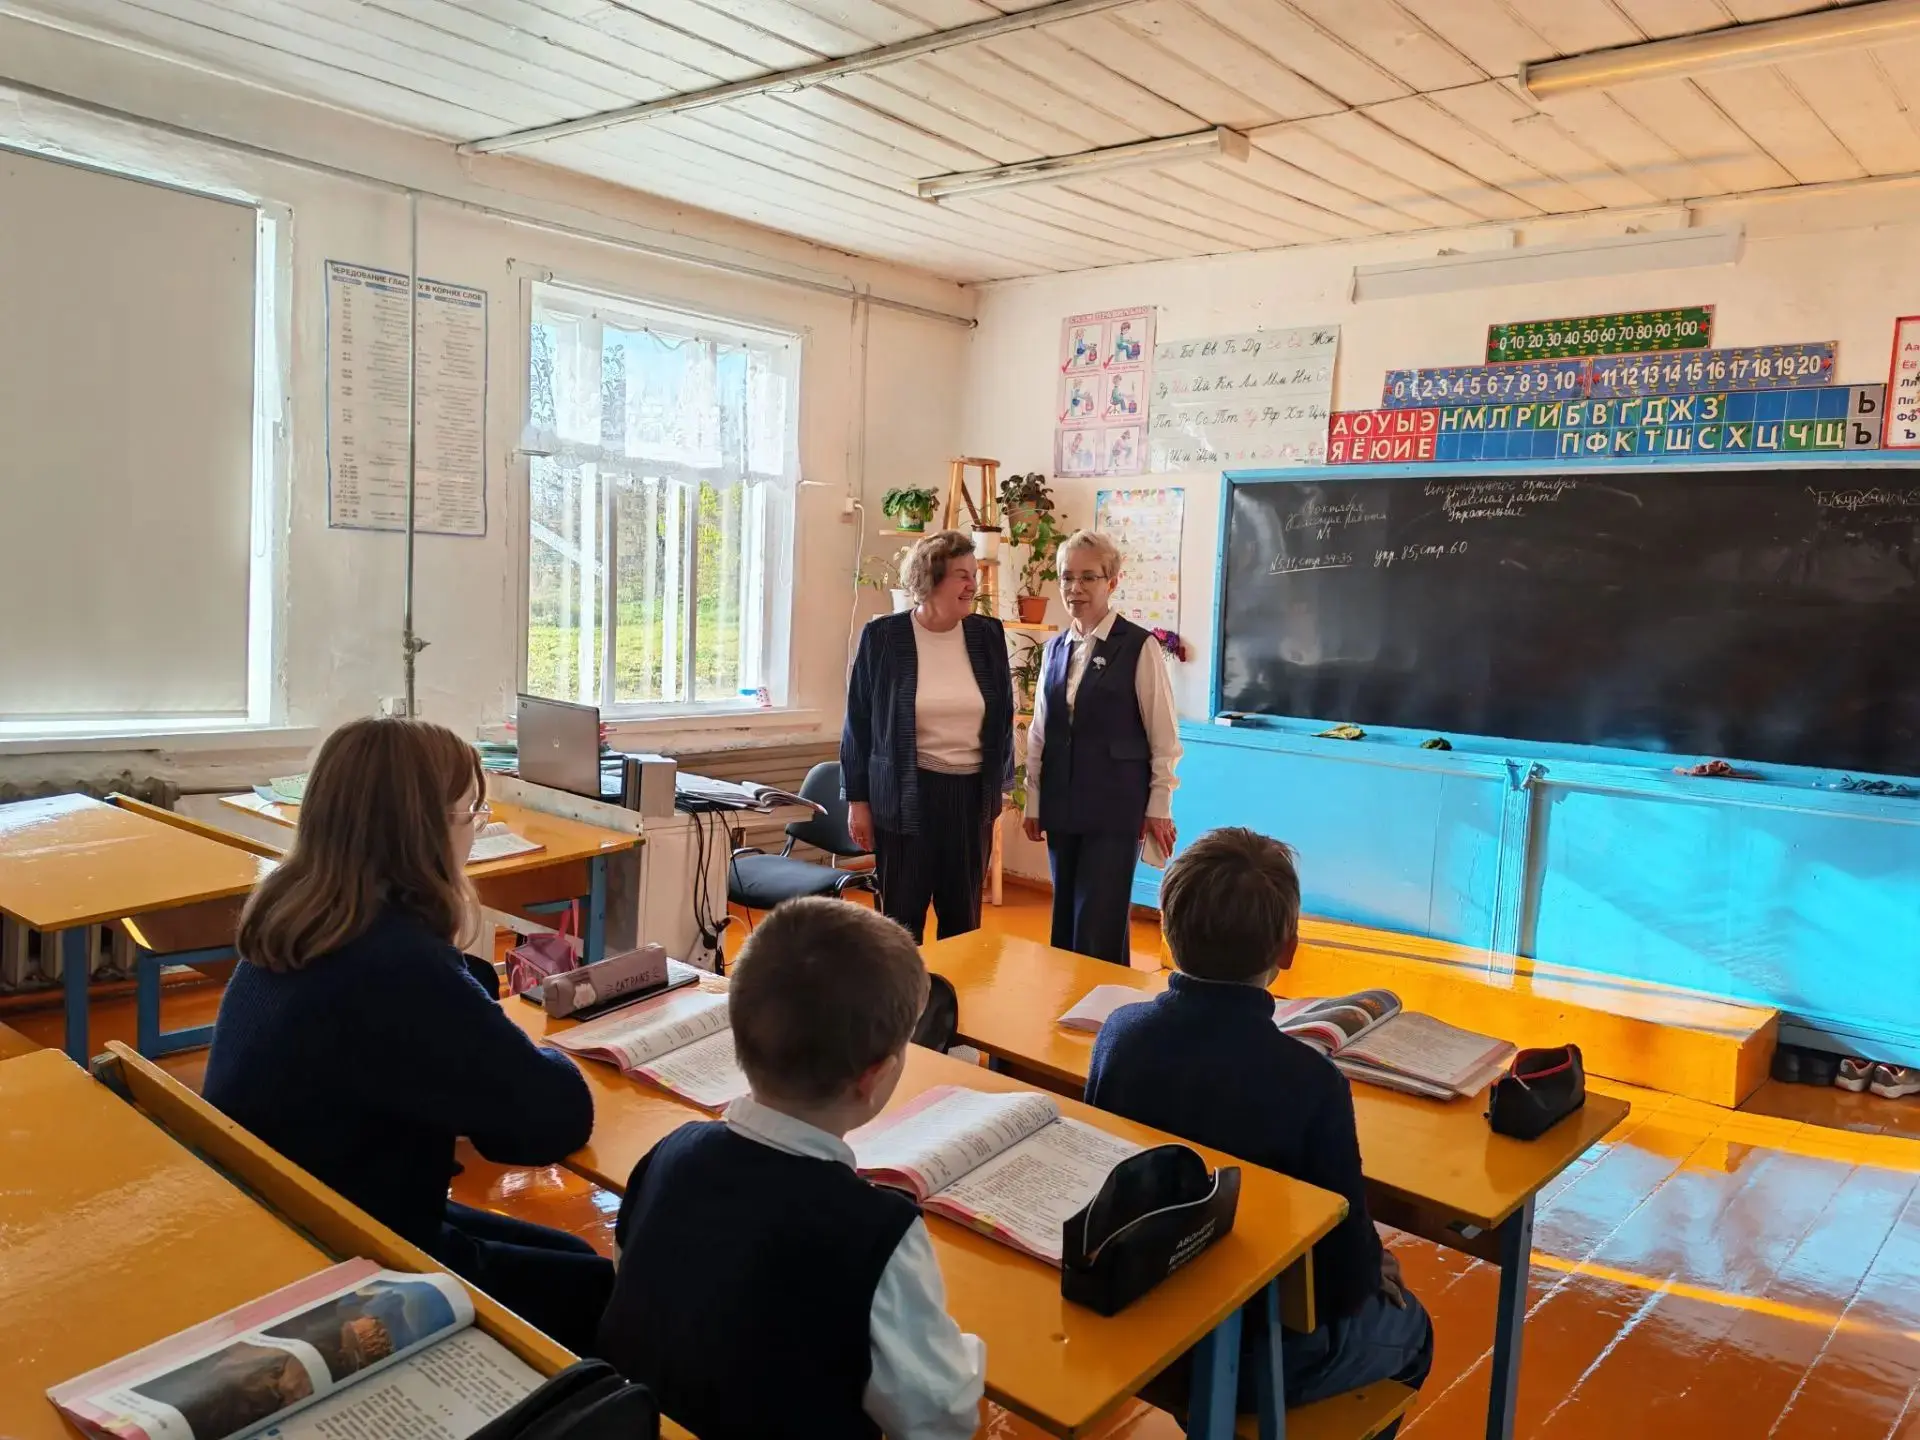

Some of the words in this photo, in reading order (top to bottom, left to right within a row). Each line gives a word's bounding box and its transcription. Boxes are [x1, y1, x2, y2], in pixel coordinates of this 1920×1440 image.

[463, 291, 482, 301] СЛОВ
[1500, 337, 1507, 350] 0
[1510, 336, 1524, 349] 10
[1528, 334, 1542, 348] 20
[1546, 332, 1562, 347] 30
[1564, 331, 1580, 345] 40
[1583, 329, 1598, 344] 50
[1600, 328, 1616, 342] 60
[1619, 326, 1634, 340] 70
[1636, 324, 1652, 339] 80
[1655, 323, 1671, 338] 90
[1674, 321, 1697, 336] 100
[1395, 381, 1404, 398] 0
[1410, 381, 1418, 398] 1
[1422, 380, 1432, 397] 2
[1438, 379, 1448, 396] 3
[1453, 378, 1464, 395] 4
[1470, 377, 1480, 395] 5
[1487, 376, 1498, 394] 6
[1504, 375, 1514, 393] 7
[1520, 374, 1530, 392] 8
[1537, 373, 1548, 391] 9
[1554, 371, 1576, 390] 10
[1602, 368, 1617, 386] 11
[1620, 367, 1638, 385] 12
[1642, 365, 1659, 384] 13
[1663, 364, 1681, 382] 14
[1684, 363, 1703, 381] 15
[1706, 361, 1725, 380] 16
[1729, 360, 1749, 378] 17
[1752, 359, 1771, 377] 18
[1774, 357, 1794, 376] 19
[1797, 355, 1821, 375] 20
[1332, 416, 1348, 435] А
[1353, 415, 1371, 434] О
[1374, 414, 1391, 434] У
[1396, 412, 1415, 432] Ы
[1420, 411, 1435, 432] Э
[1441, 411, 1458, 430] Н
[1462, 410, 1484, 429] М
[1488, 409, 1506, 429] Л
[1517, 408, 1531, 428] Р
[1539, 404, 1559, 427] Й
[1566, 405, 1581, 426] Б
[1592, 404, 1607, 425] В
[1620, 402, 1634, 424] Г
[1642, 401, 1664, 425] Д
[1669, 399, 1693, 421] Ж
[1701, 398, 1718, 420] З
[1859, 390, 1876, 415] Ь
[1332, 442, 1344, 460] Я
[1352, 437, 1366, 460] Ё
[1370, 440, 1390, 459] Ю
[1393, 439, 1411, 458] И
[1419, 438, 1432, 458] Е
[1562, 433, 1579, 453] П
[1586, 431, 1608, 453] Ф
[1615, 430, 1632, 452] К
[1645, 430, 1661, 450] Т
[1666, 429, 1691, 450] Ш
[1698, 427, 1716, 449] С
[1726, 427, 1747, 448] Х
[1757, 426, 1778, 450] Ц
[1789, 425, 1807, 447] Ч
[1815, 423, 1846, 448] Щ
[1853, 423, 1872, 445] Ъ
[1506, 489, 1560, 508] работа
[1450, 541, 1468, 555] 60
